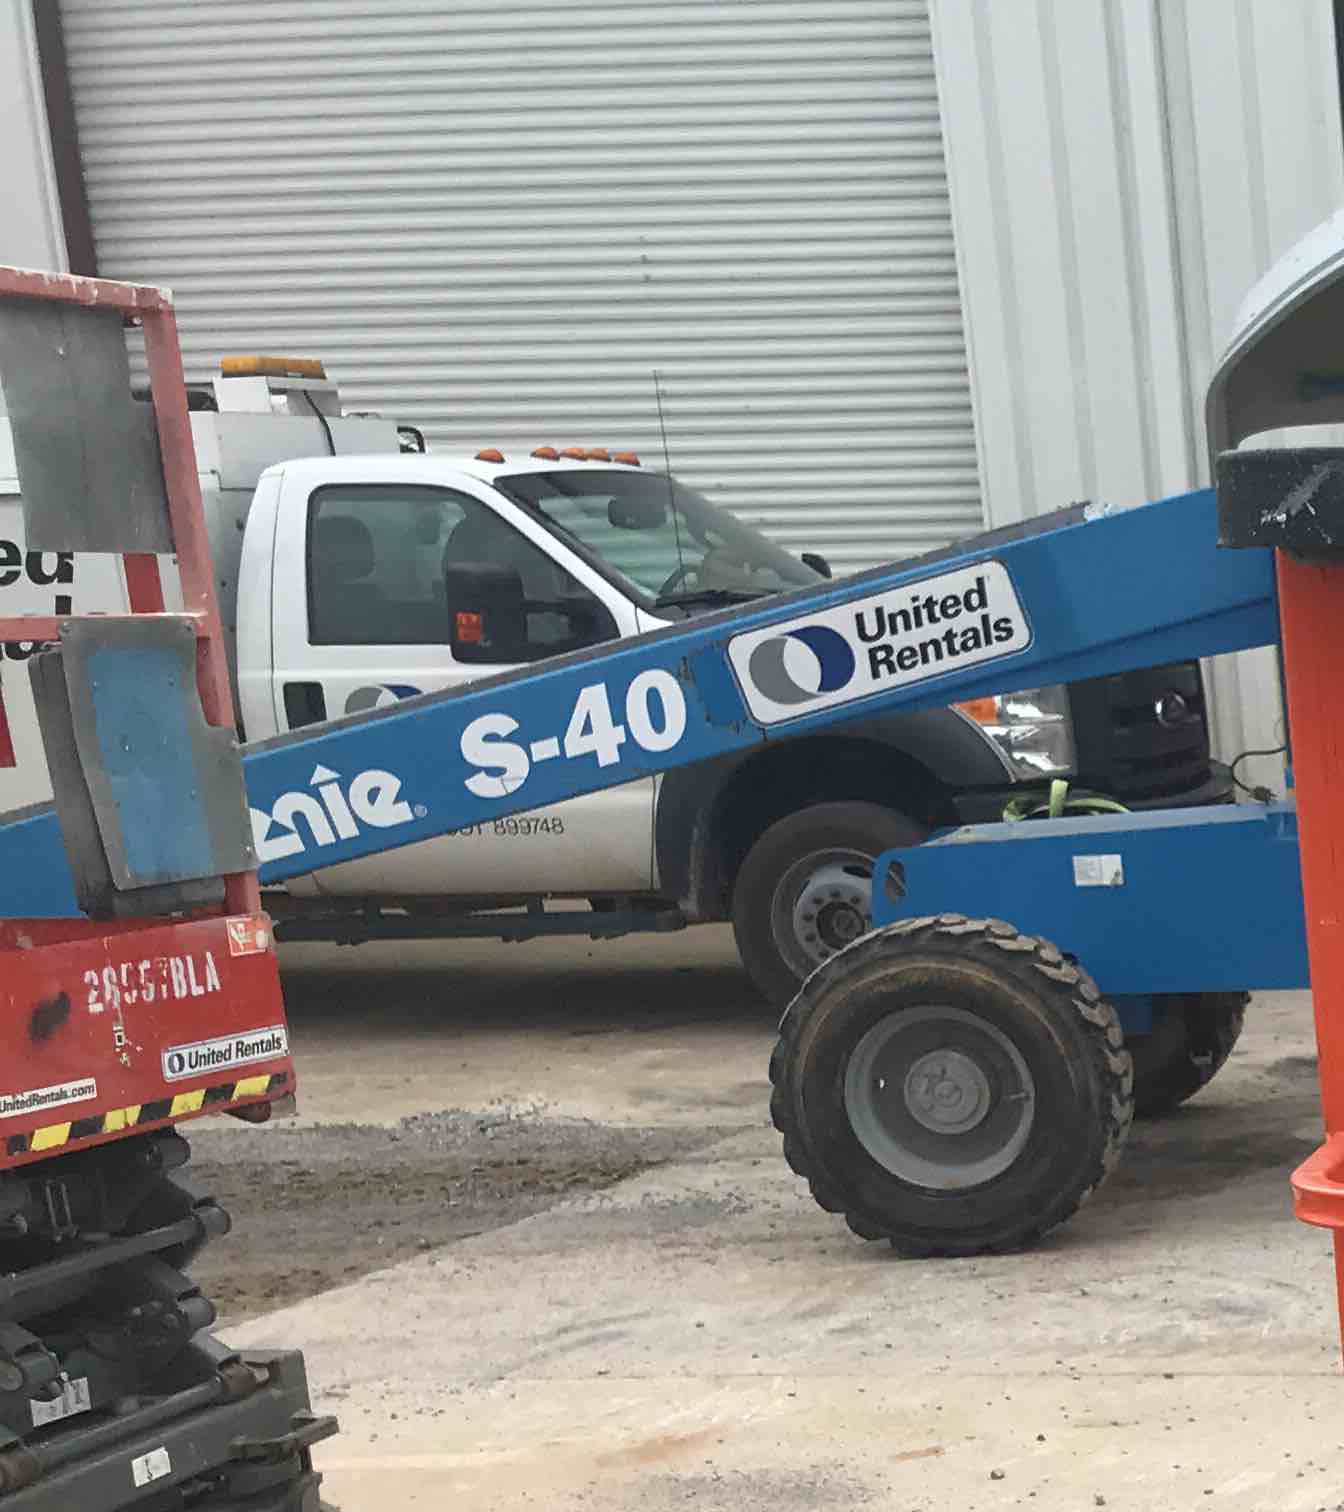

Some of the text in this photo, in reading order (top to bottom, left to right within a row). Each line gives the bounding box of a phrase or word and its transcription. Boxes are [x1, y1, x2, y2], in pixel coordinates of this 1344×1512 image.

[855, 577, 989, 643] United
[868, 613, 1014, 681] Rentals
[249, 668, 687, 864] enie S-40
[188, 1033, 283, 1071] United Rentals
